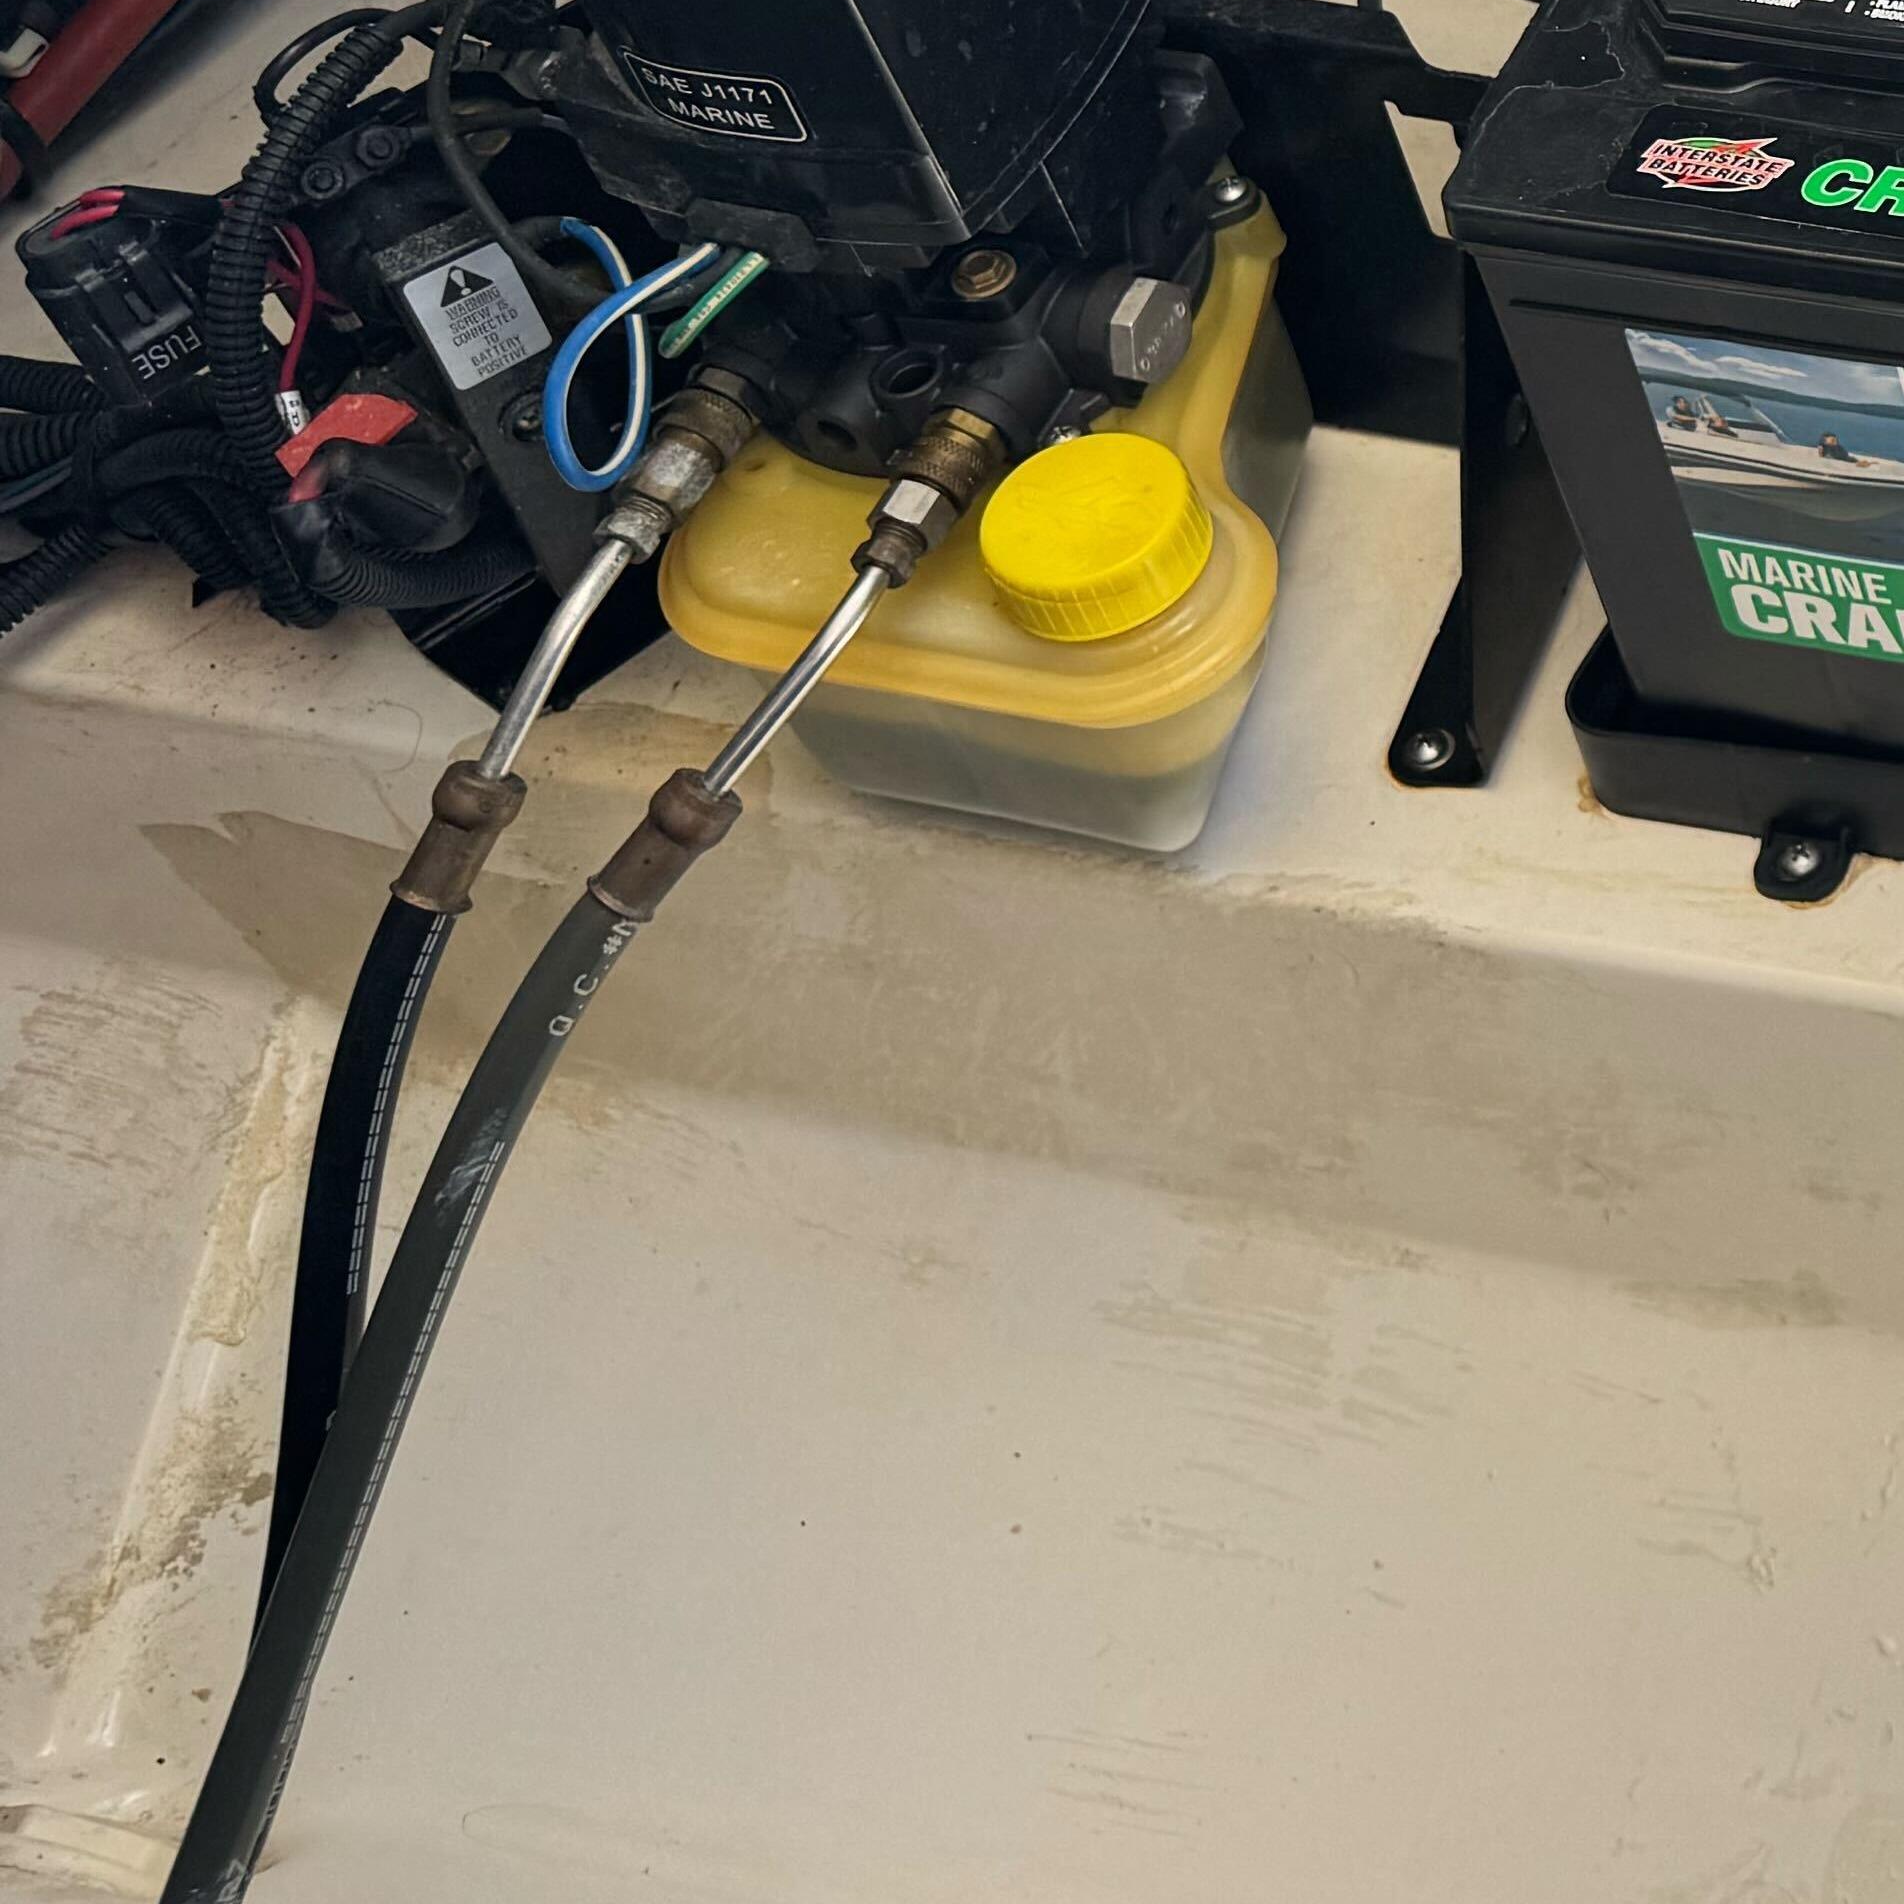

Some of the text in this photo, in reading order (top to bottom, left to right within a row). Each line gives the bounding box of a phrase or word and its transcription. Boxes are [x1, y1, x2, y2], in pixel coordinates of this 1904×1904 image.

[642, 68, 773, 105] SAE J1171
[667, 98, 776, 130] MARINE
[1647, 157, 1767, 188] BATTERIES
[1652, 141, 1784, 174] INTERSTATE
[445, 285, 501, 320] WARNING
[449, 306, 491, 335] SCREW
[453, 308, 519, 348] CONNECTED
[131, 325, 202, 380] FUSE
[471, 335, 521, 366] BATTERY
[483, 332, 500, 347] TO
[477, 346, 528, 376] POSITIVE
[1718, 548, 1892, 606] MARINE
